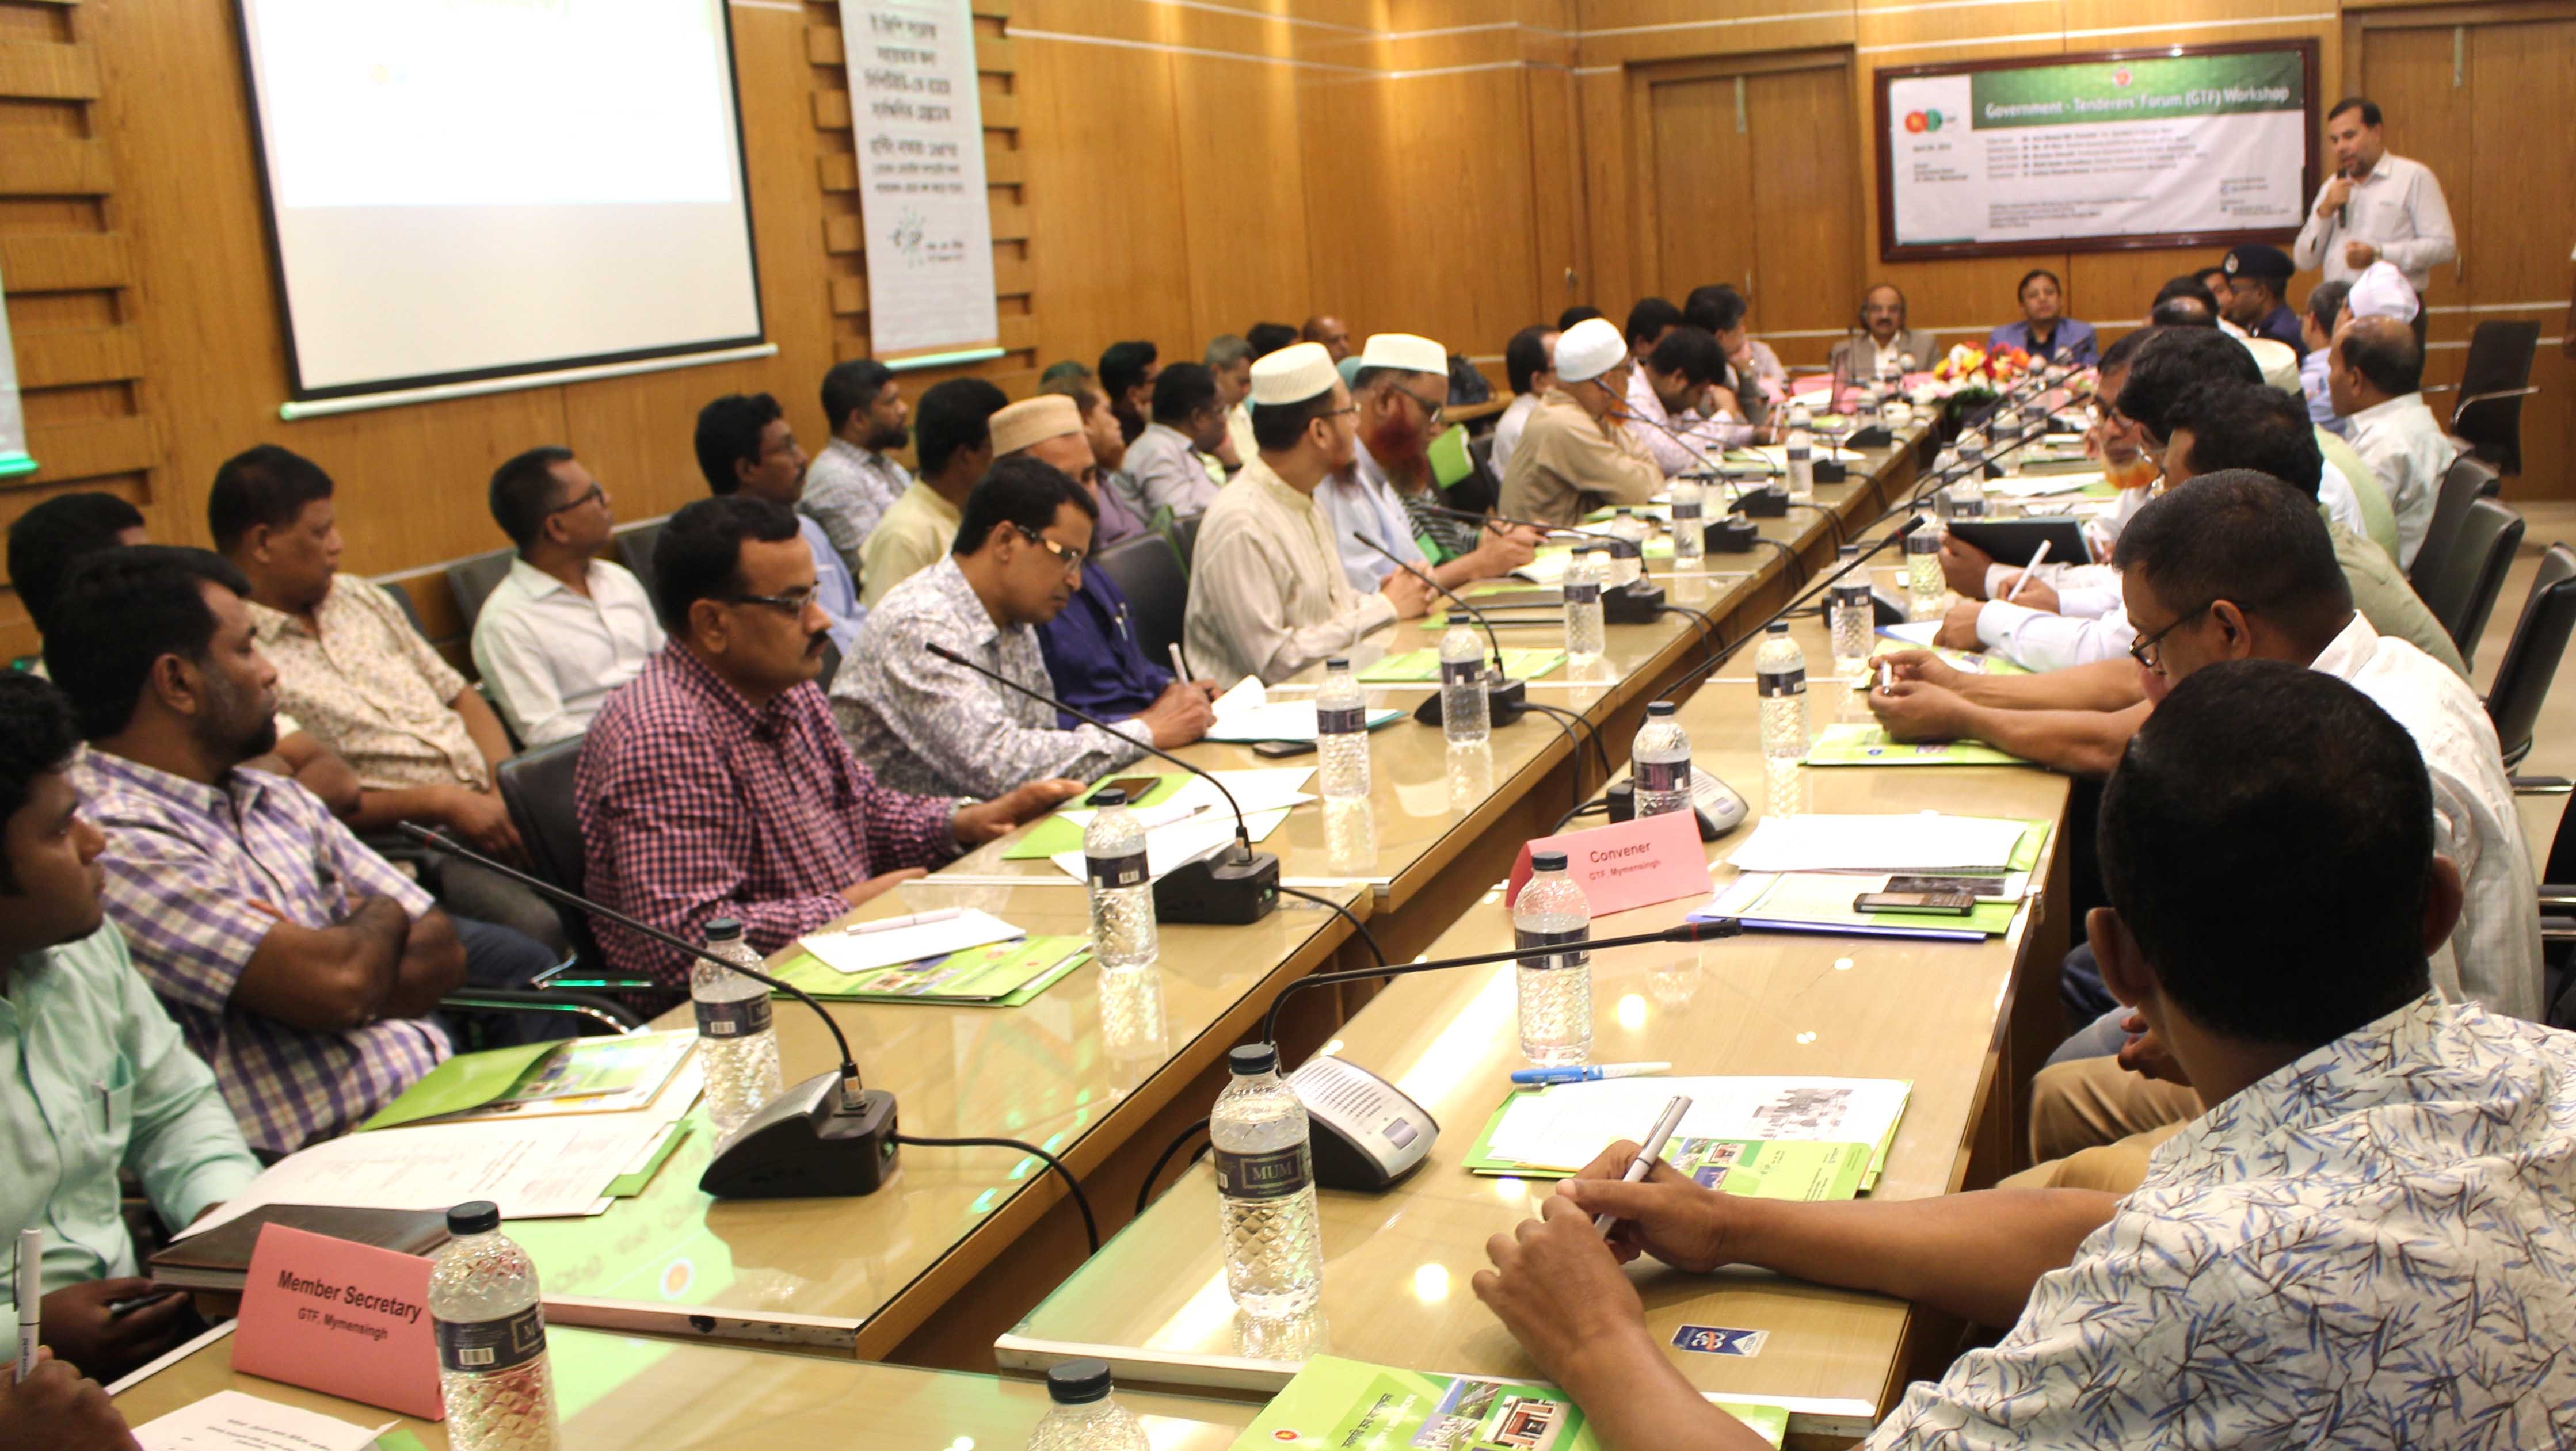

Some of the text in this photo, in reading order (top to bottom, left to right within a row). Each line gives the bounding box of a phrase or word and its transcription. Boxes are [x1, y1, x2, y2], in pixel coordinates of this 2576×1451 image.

[1985, 101, 2063, 119] Government
[2140, 93, 2182, 109] Forum
[2185, 88, 2221, 108] (GTF)
[2223, 85, 2289, 104] Workshop
[1590, 842, 1650, 863] Convener
[1252, 1160, 1293, 1180] MUM
[277, 1270, 422, 1324] Member Secretary
[323, 1313, 388, 1341] Mymensingh
